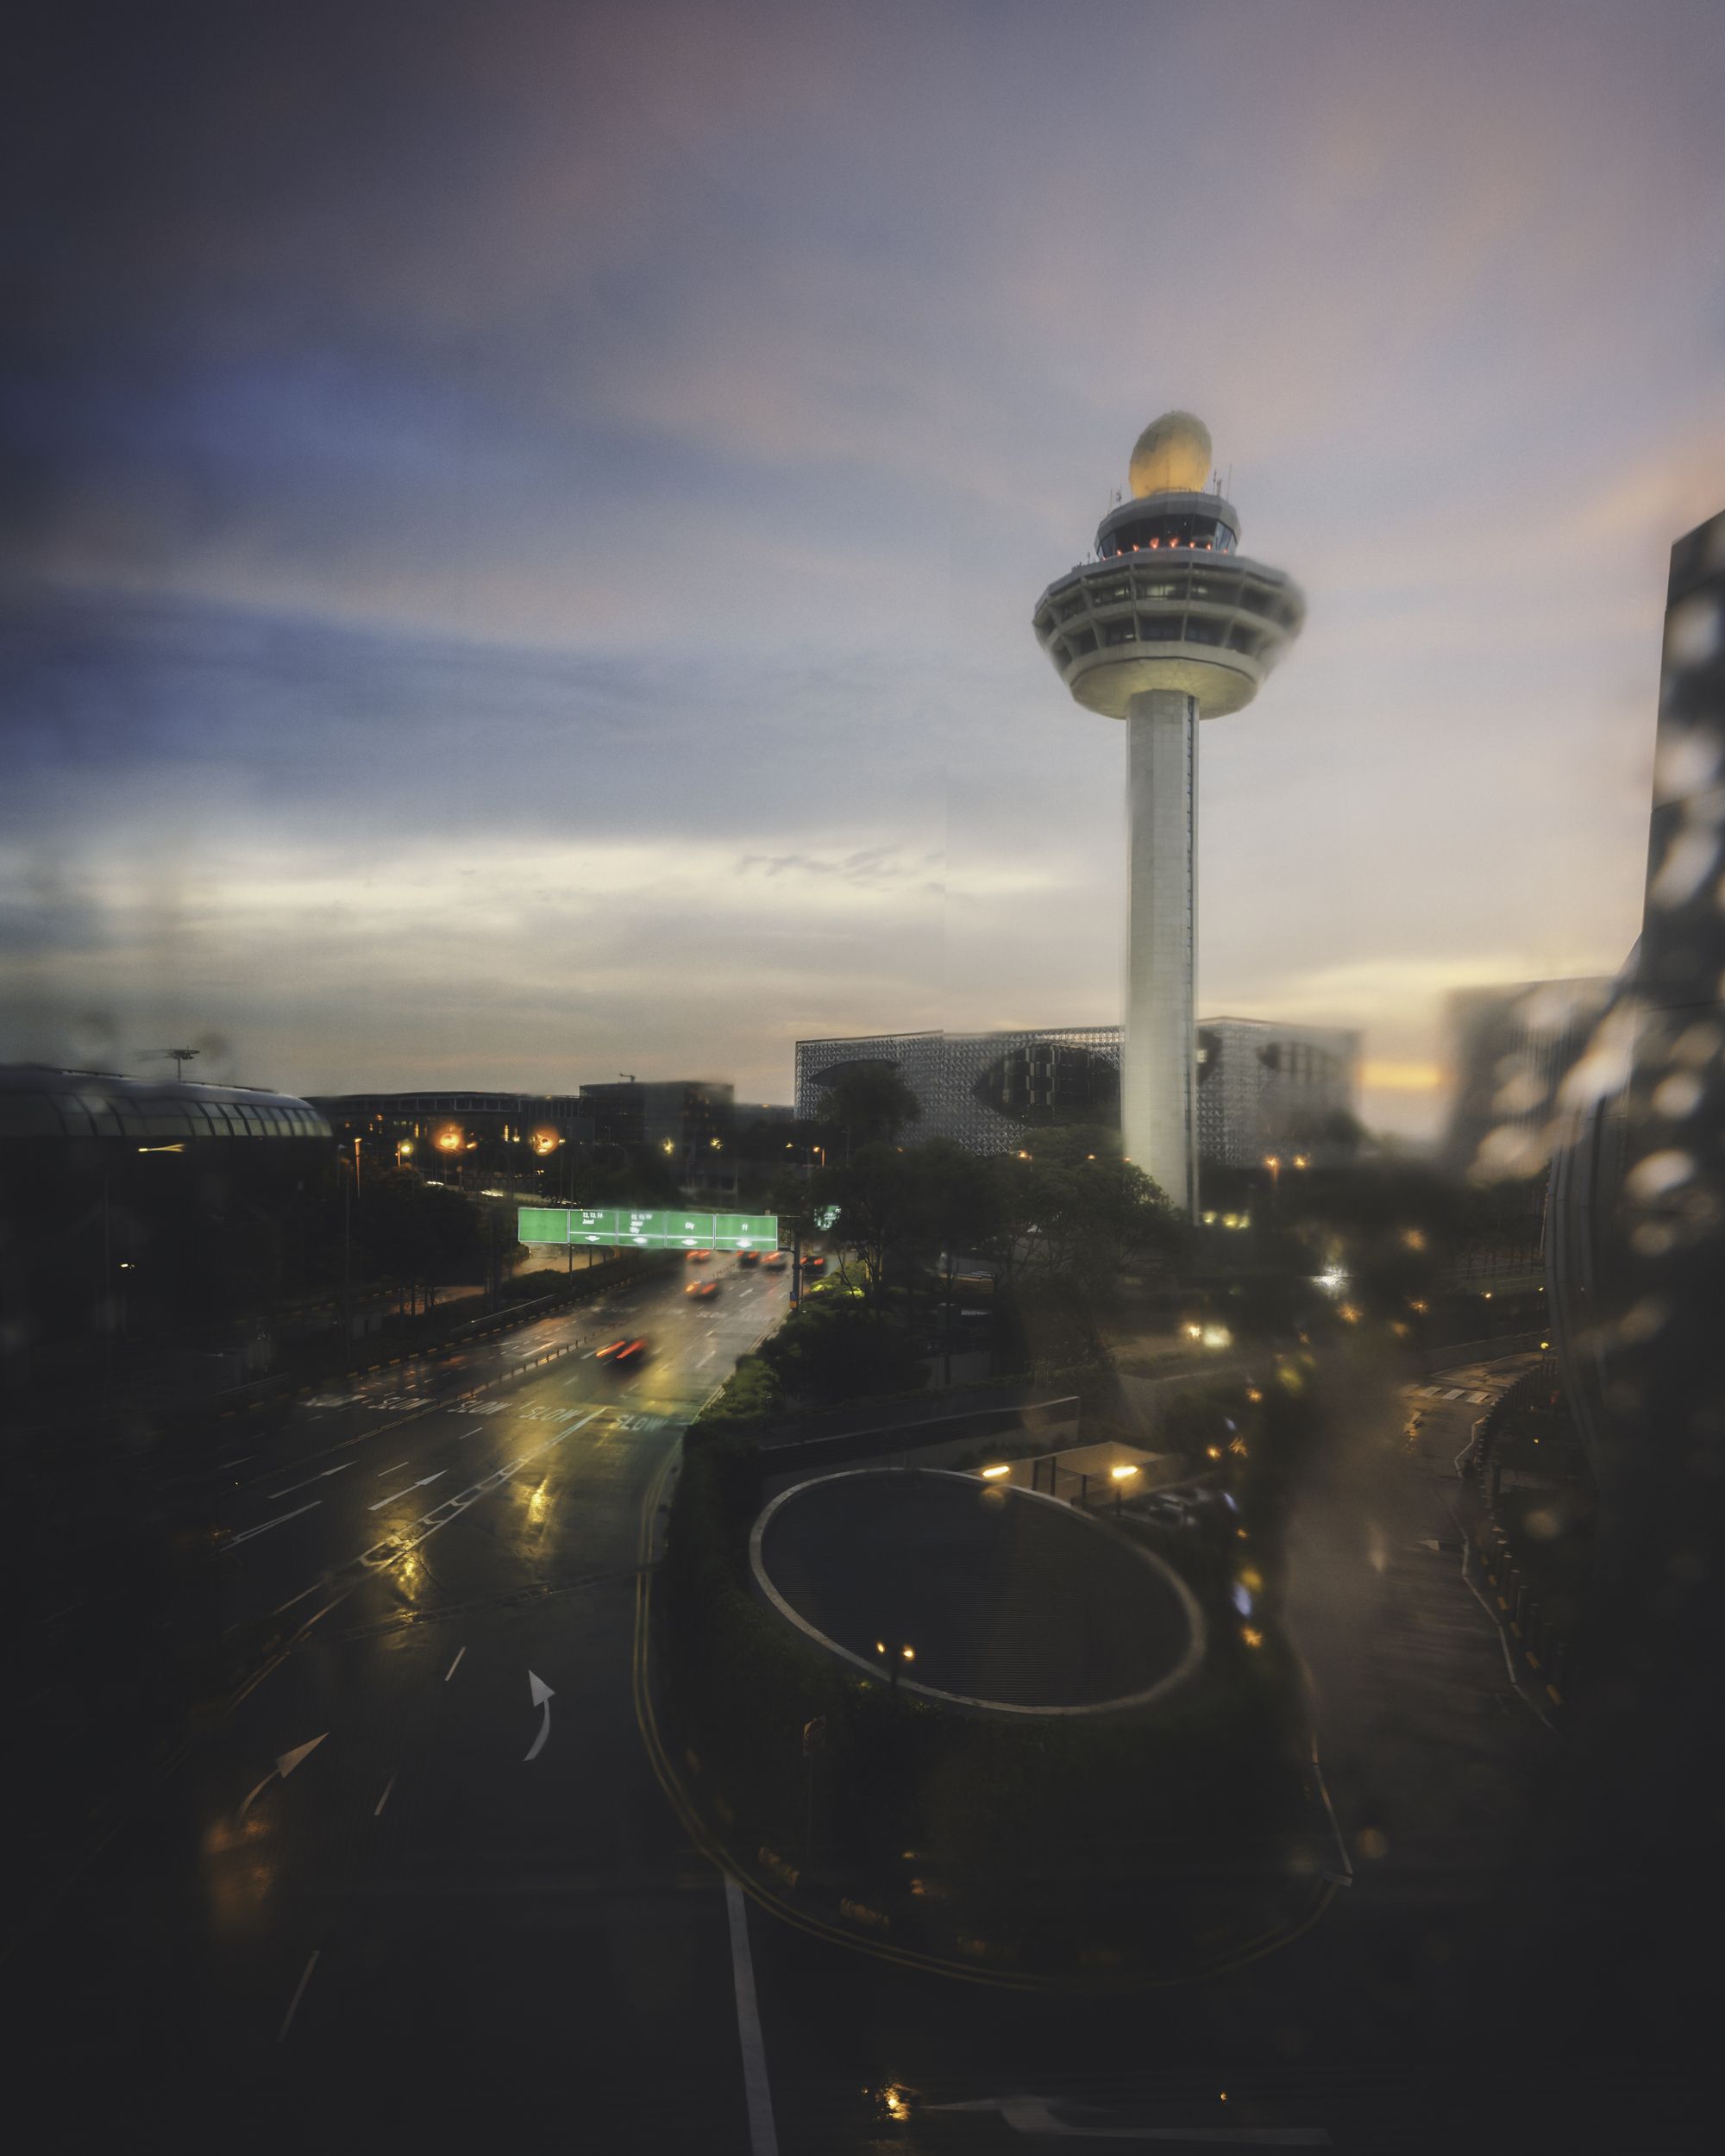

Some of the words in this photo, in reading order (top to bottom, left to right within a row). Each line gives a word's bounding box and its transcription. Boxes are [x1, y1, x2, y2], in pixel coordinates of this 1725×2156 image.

[367, 1397, 436, 1411] SLOW
[446, 1401, 512, 1414] SLOW
[519, 1407, 586, 1423] SLOW
[615, 1414, 668, 1431] SLOW
